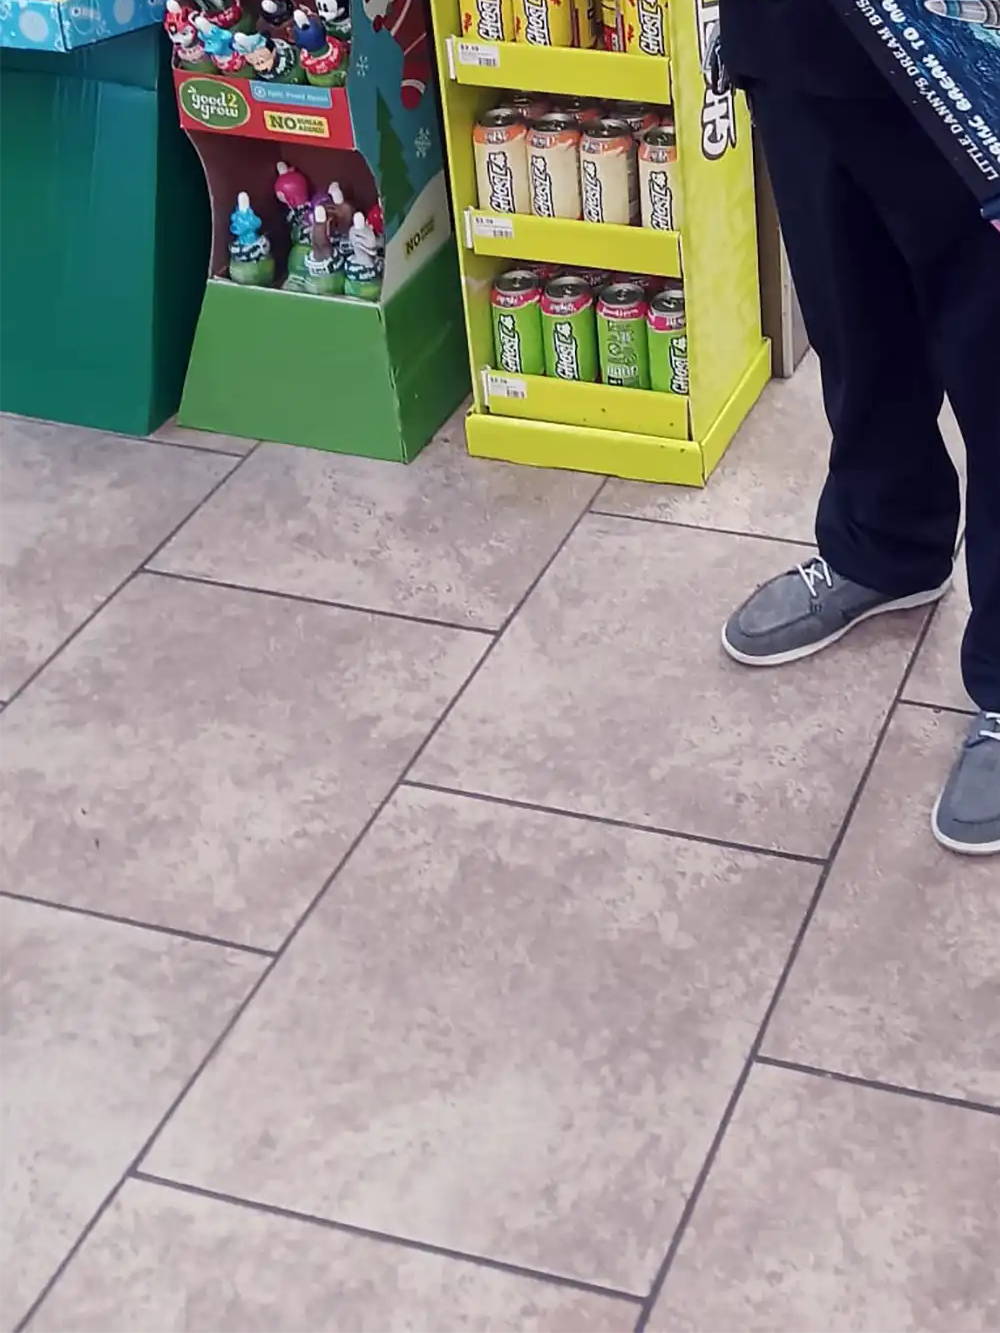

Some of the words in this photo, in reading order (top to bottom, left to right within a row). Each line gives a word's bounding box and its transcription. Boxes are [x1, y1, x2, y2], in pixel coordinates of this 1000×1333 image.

[876, 26, 920, 77] DREAM
[903, 26, 926, 50] TO
[922, 53, 972, 112] BREAK
[200, 105, 239, 120] grow
[269, 114, 297, 131] NO
[914, 77, 965, 135] DANNY'S
[957, 134, 999, 181] LITTLE
[406, 232, 421, 255] NO
